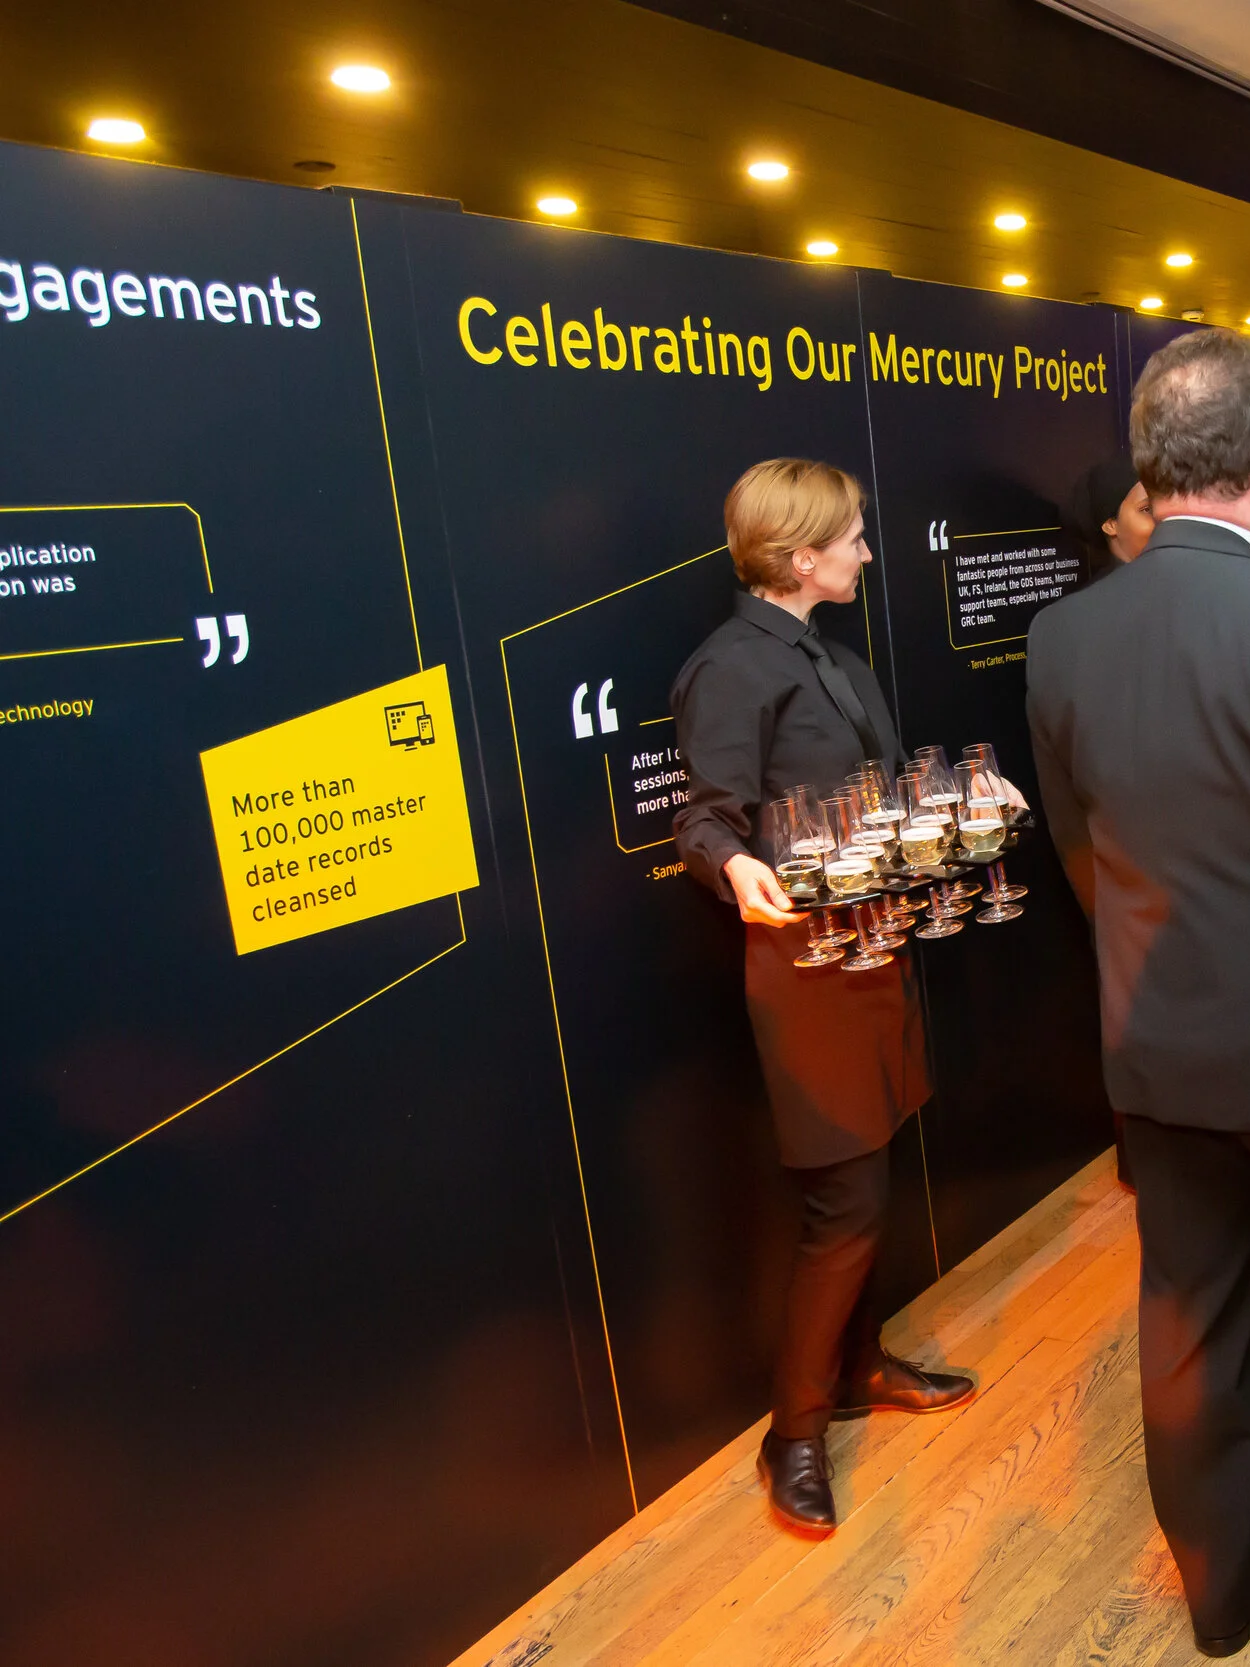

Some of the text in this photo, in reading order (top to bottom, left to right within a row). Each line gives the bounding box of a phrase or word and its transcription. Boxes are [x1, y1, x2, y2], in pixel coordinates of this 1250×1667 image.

[458, 296, 1108, 402] Celebrating Our Mercury Project
[955, 547, 1057, 567] I have met and worked with some
[957, 558, 1080, 582] fantastic people from across our business
[32, 575, 76, 594] was
[958, 572, 1078, 598] UK, FS, Ireland, the GDS teams, Mercury
[960, 586, 1063, 614] support teams, especially the MST
[961, 613, 996, 628] GRC team.
[970, 659, 986, 669] Terry
[986, 655, 1005, 667] Carter,
[632, 752, 664, 771] After
[667, 747, 672, 762] I
[634, 769, 690, 793] sessions,
[231, 777, 355, 818] More than
[637, 796, 669, 815] more
[239, 794, 426, 853] 100,000 master
[245, 835, 393, 888] date records
[652, 861, 687, 880] Sanya
[251, 875, 357, 923] cleansed
